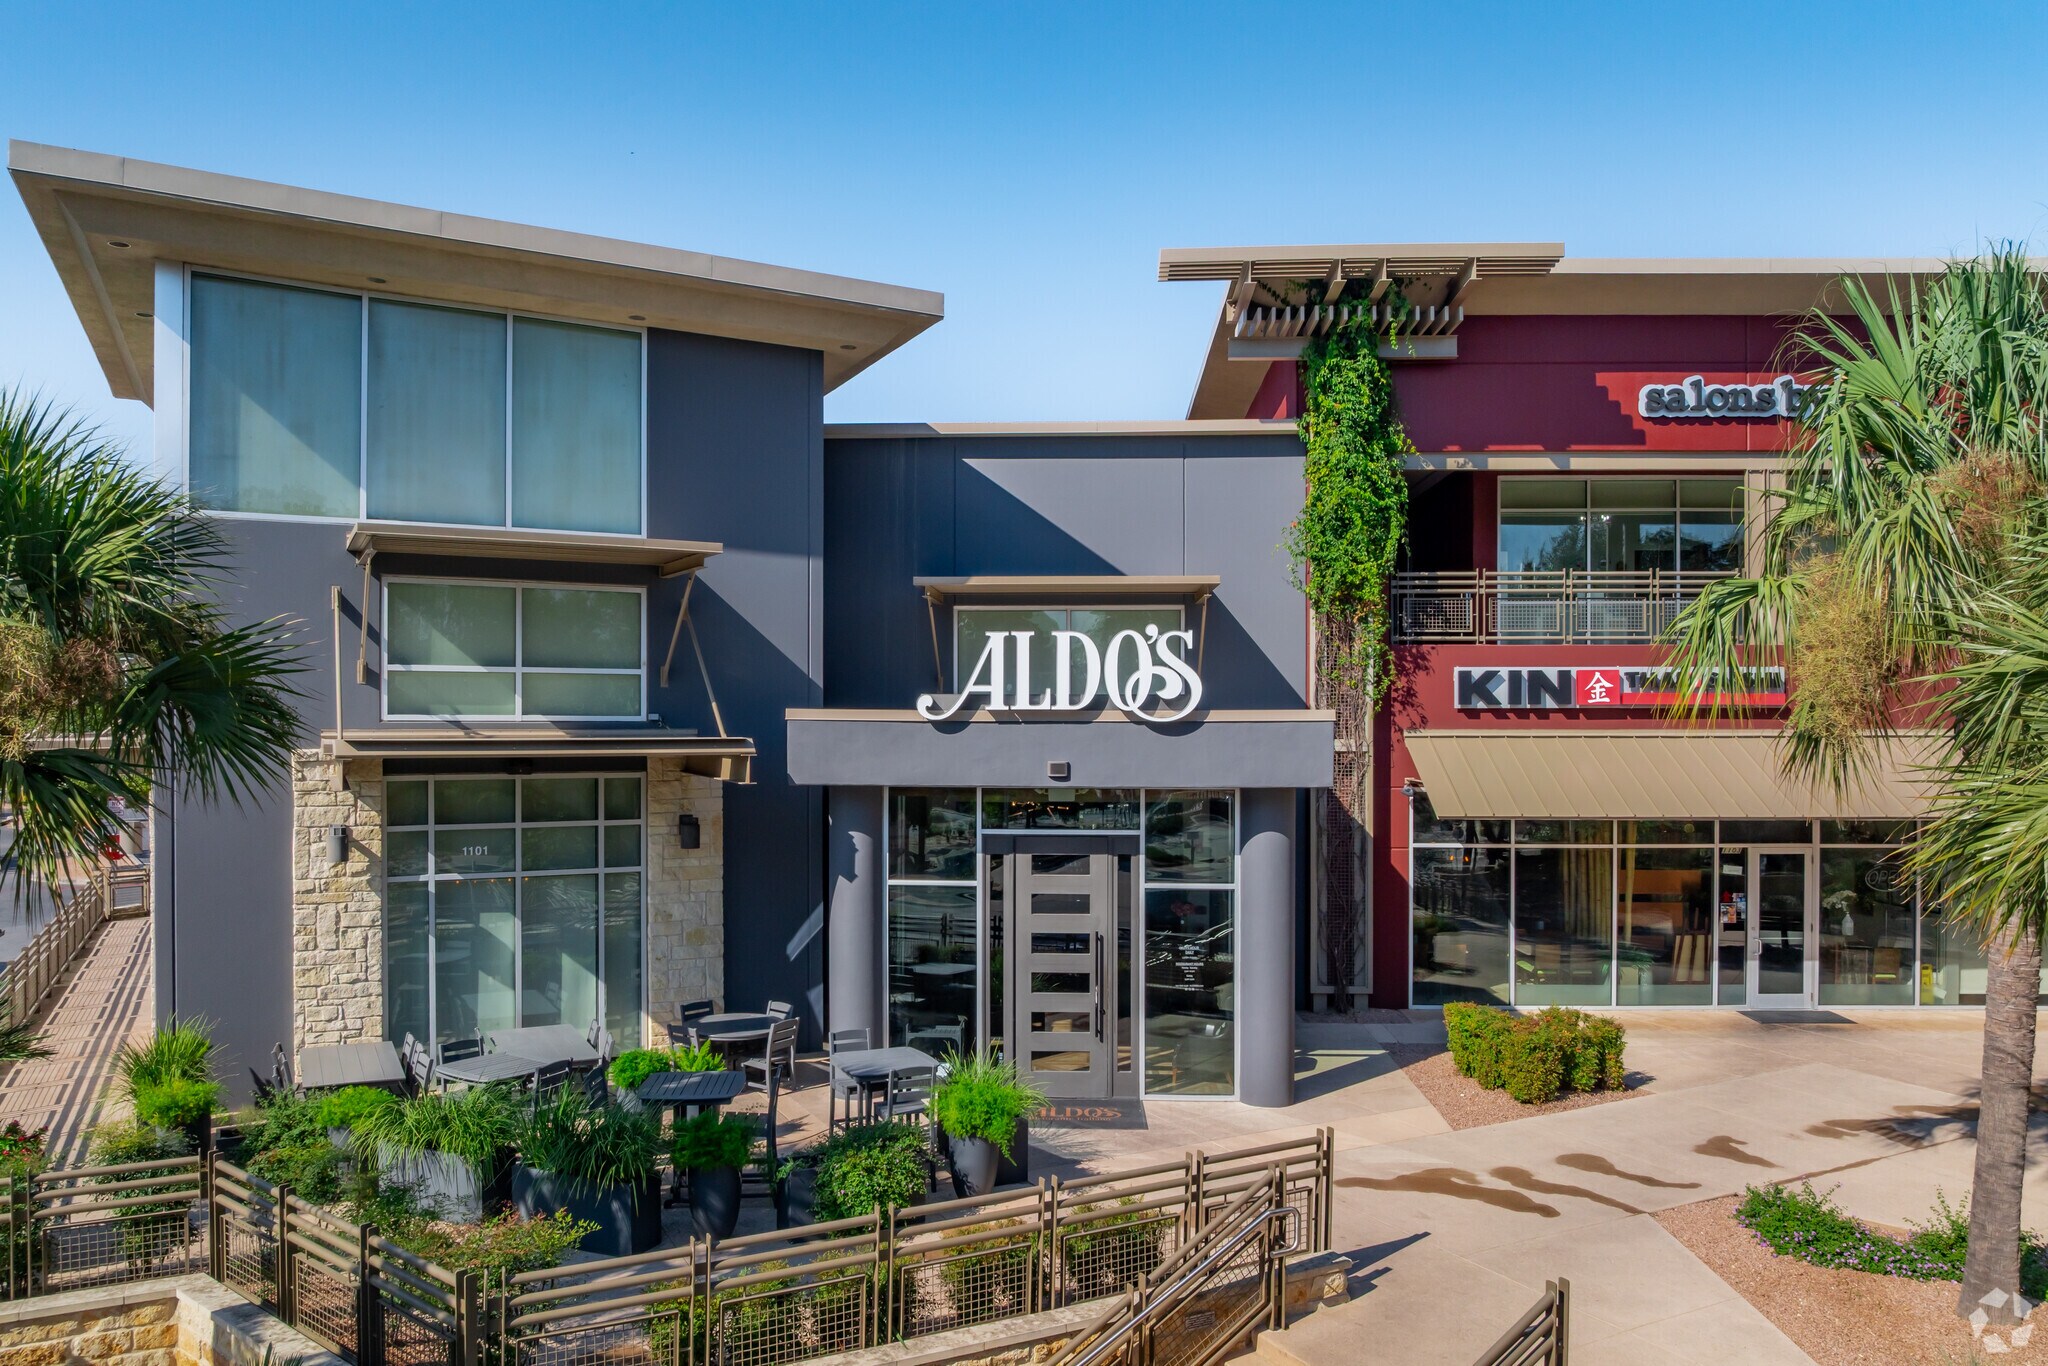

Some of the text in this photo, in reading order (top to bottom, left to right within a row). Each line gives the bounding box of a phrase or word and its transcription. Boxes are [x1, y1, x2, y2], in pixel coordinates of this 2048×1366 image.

[1645, 378, 1776, 413] salons
[916, 623, 1203, 723] ALDO'S
[1458, 670, 1572, 705] KIN
[1584, 671, 1614, 704] 金
[462, 845, 488, 856] 1101
